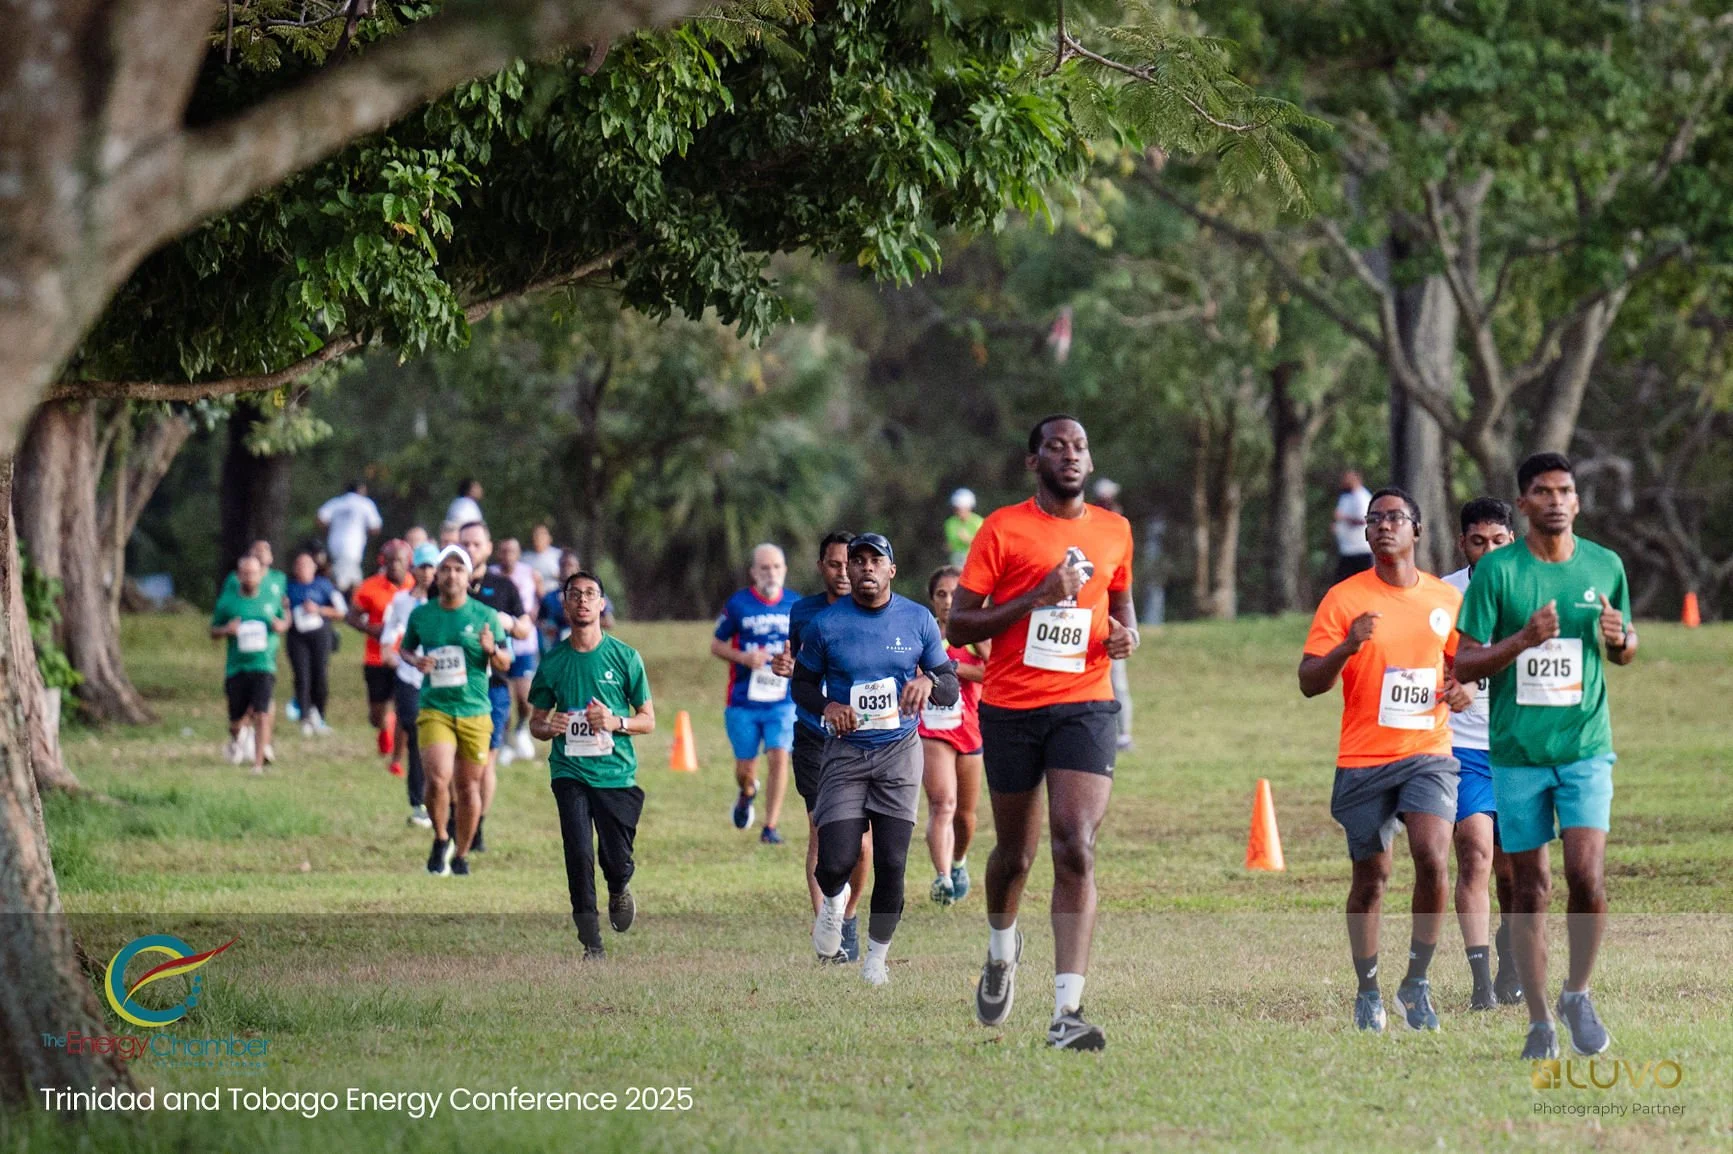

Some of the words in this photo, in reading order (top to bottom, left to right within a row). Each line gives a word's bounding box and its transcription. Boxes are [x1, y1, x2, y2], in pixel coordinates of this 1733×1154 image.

[1036, 623, 1082, 646] 0488
[1527, 658, 1571, 677] 0215
[858, 693, 892, 710] 0331
[1391, 684, 1429, 704] 0158
